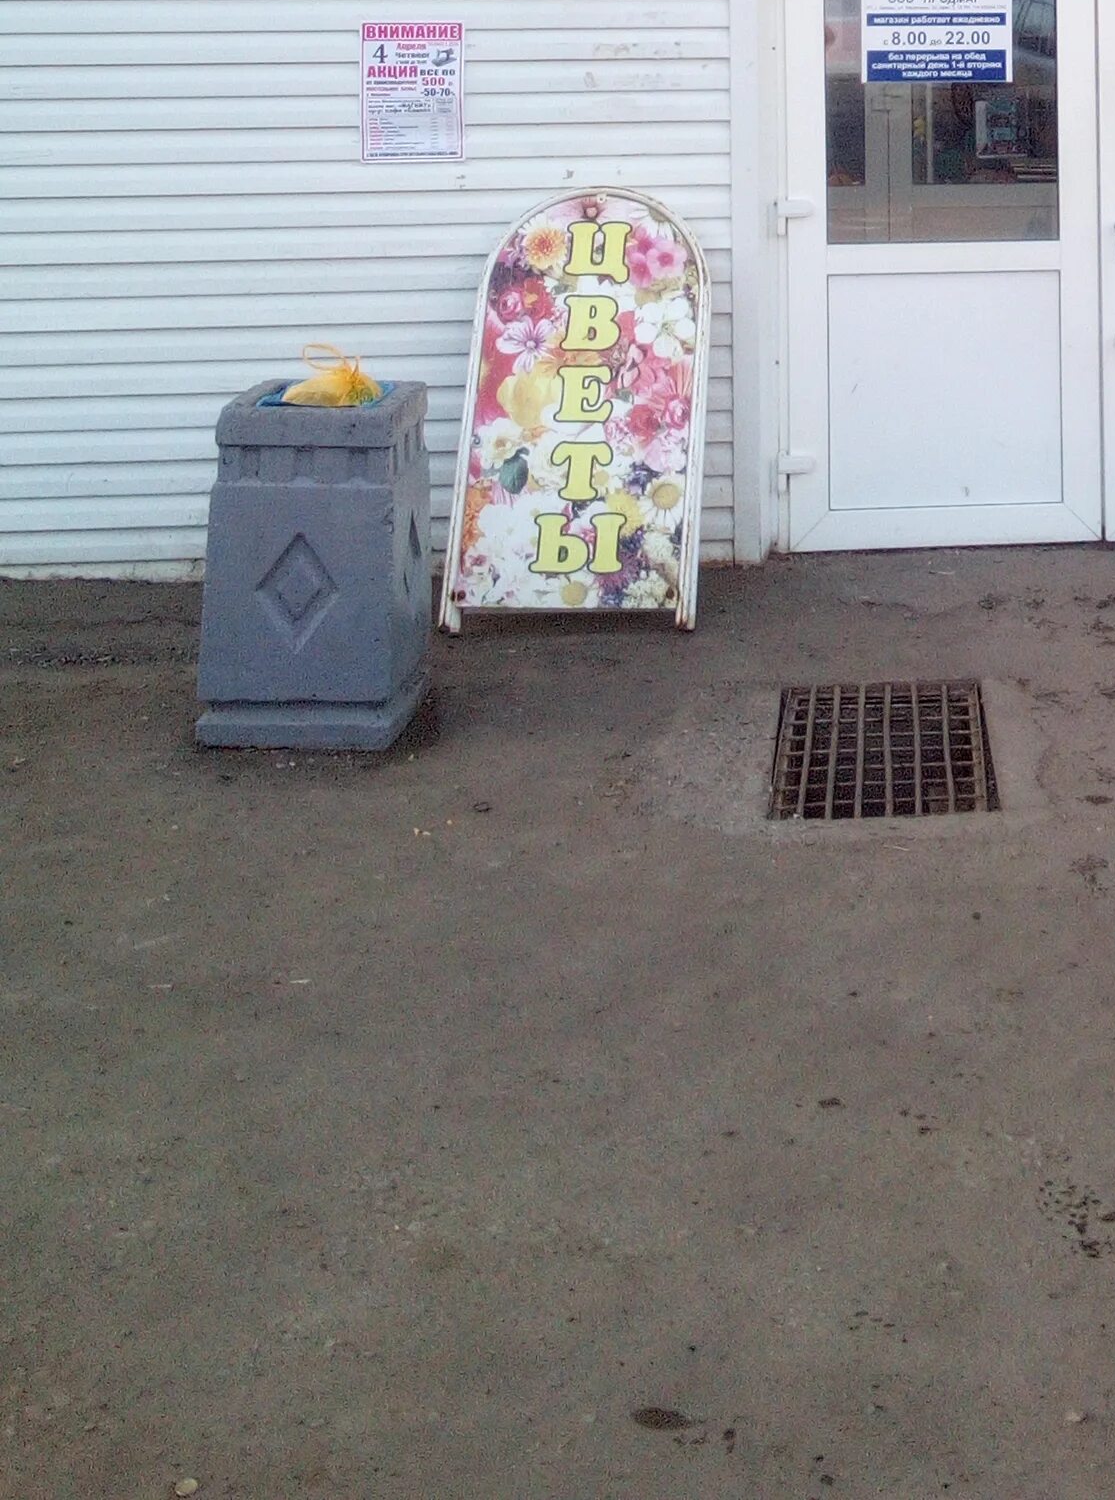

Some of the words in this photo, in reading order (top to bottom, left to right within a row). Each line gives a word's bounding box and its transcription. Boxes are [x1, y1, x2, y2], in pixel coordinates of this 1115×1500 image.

[874, 17, 910, 25] магазин
[911, 15, 951, 25] работает
[366, 25, 458, 39] ВНИМАНИЕ
[891, 31, 927, 46] 8.00
[945, 31, 991, 46] 22.00
[372, 43, 389, 64] 4
[367, 65, 418, 79] АКЦИЯ
[421, 77, 446, 87] 500
[528, 221, 633, 575] ЦВЕТЫ
